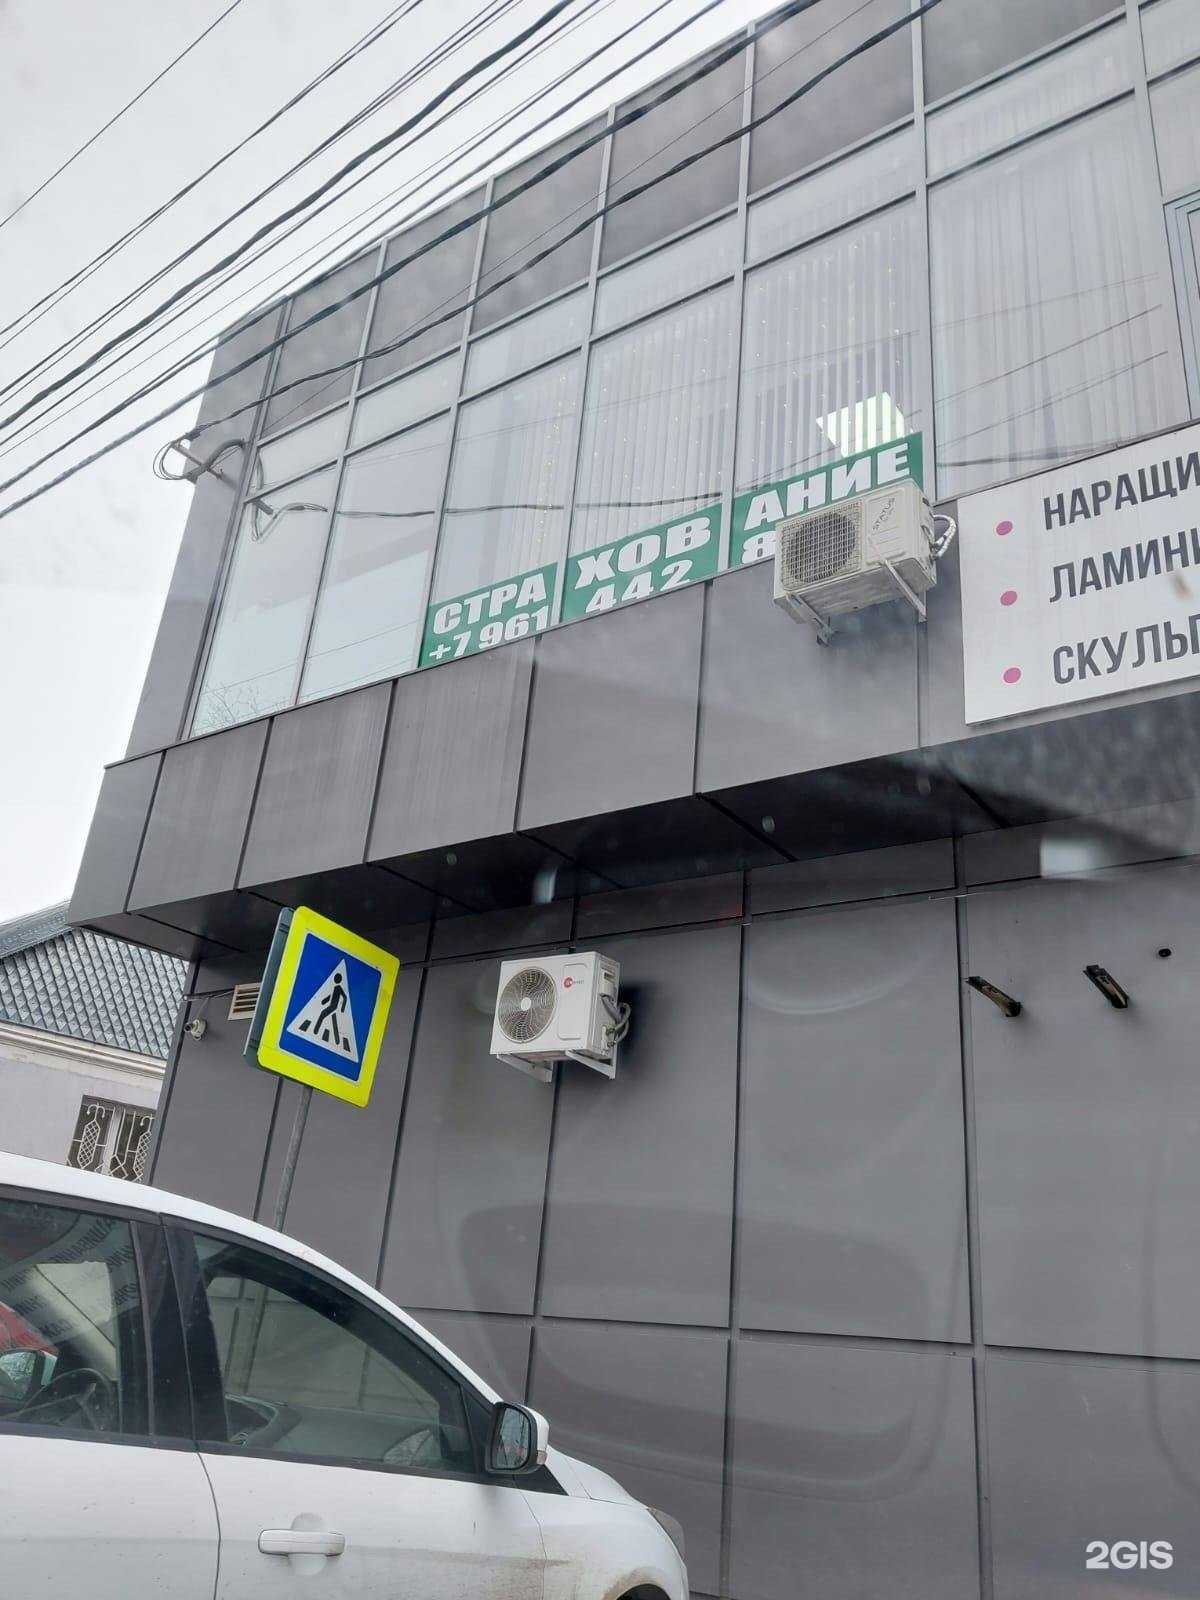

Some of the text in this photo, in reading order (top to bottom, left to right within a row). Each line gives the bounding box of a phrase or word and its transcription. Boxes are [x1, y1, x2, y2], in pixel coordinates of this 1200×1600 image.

[1043, 451, 1200, 530] НАРАЩИ
[434, 573, 547, 634] СТРА
[574, 517, 711, 590] ХОВ
[743, 442, 910, 531] АНИЕ
[479, 605, 549, 649] 961
[585, 559, 693, 613] 442
